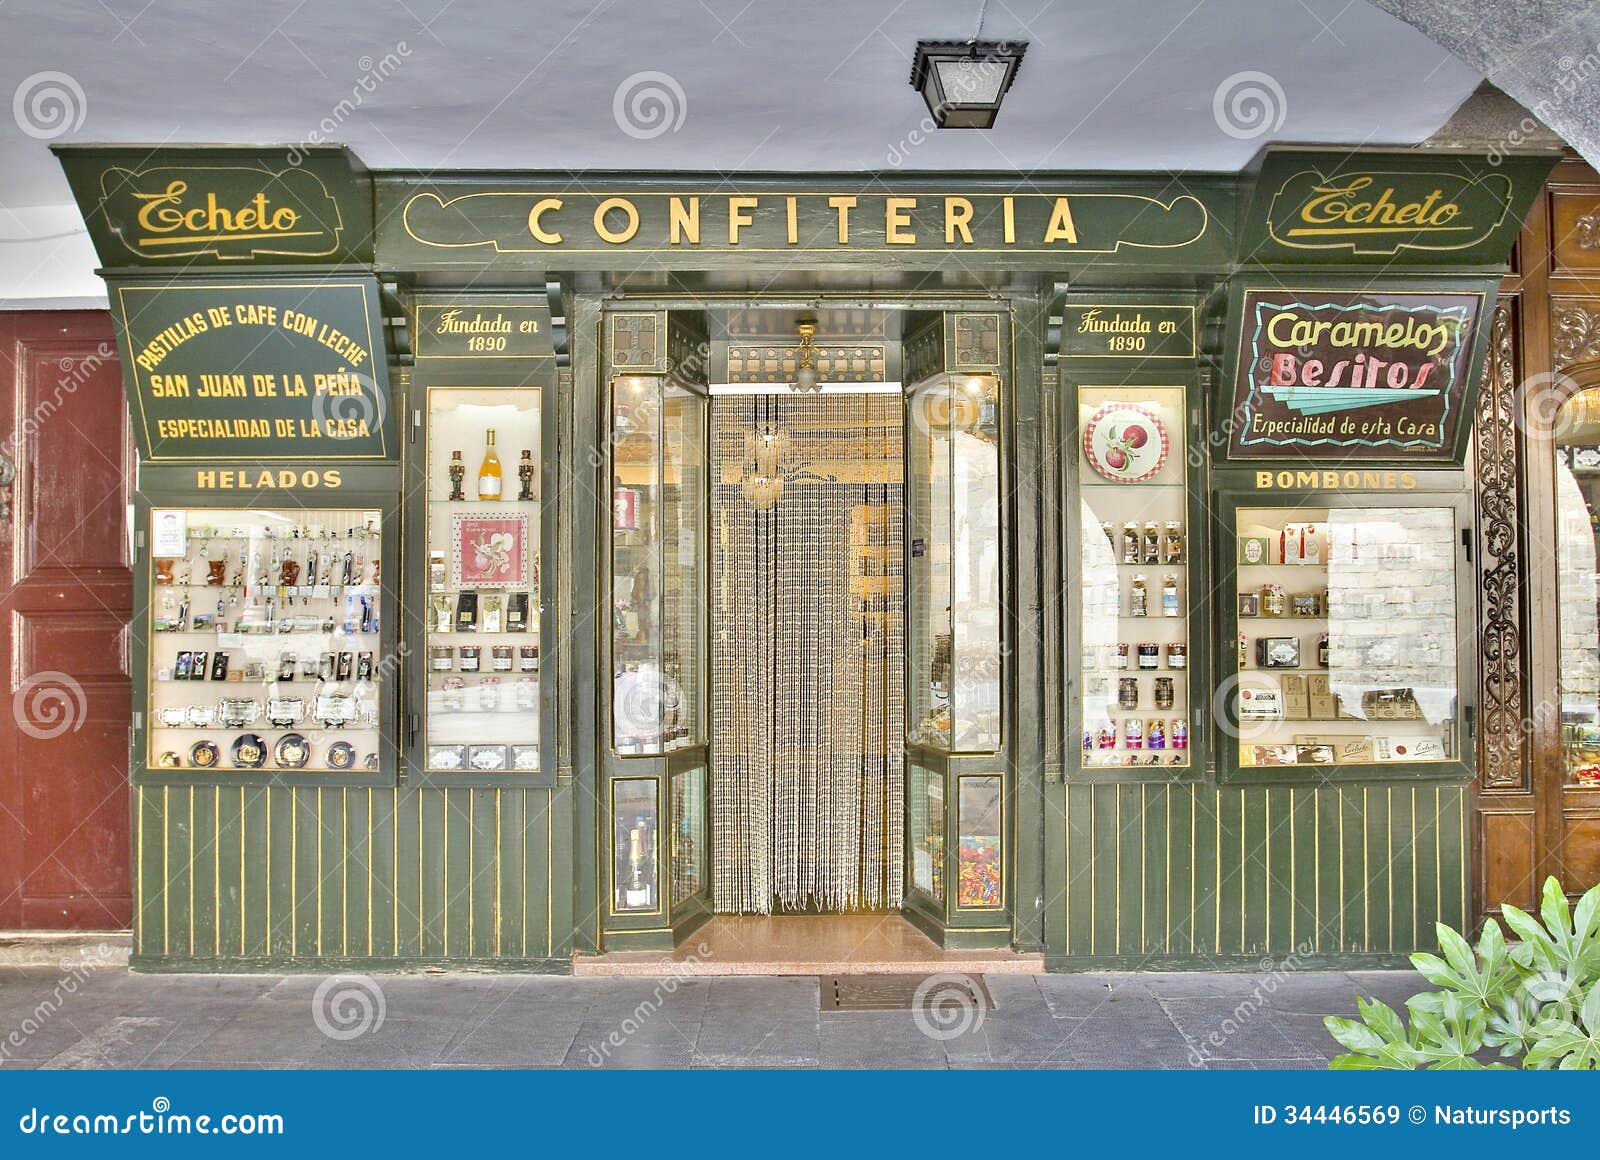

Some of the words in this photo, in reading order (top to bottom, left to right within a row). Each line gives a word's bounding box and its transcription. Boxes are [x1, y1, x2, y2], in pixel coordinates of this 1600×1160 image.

[131, 181, 302, 233] Echeto
[1301, 176, 1462, 225] Echeto
[528, 197, 1078, 245] CONFITERIA
[436, 309, 512, 335] Fundada
[520, 320, 539, 334] en
[1077, 310, 1151, 335] Fundada
[1158, 320, 1177, 334] en
[1267, 312, 1448, 357] Caramelos
[136, 311, 209, 373] PASTILLAS
[208, 307, 232, 329] DE
[236, 304, 276, 327] CAFE
[282, 310, 318, 338] CON
[318, 324, 368, 368] LECHE
[467, 336, 507, 352] 1890
[1107, 336, 1146, 352] 1890
[151, 374, 190, 398] SAN
[197, 374, 247, 398] JUAN
[254, 374, 277, 397] DE
[284, 374, 307, 397] LA
[315, 367, 363, 397] PEÑA
[158, 418, 271, 438] ESPECIALIDAD
[275, 418, 296, 437] DE
[300, 419, 320, 437] LA
[325, 419, 370, 437] CASA
[1252, 413, 1335, 436] Especialidad
[1340, 416, 1356, 432] de
[1361, 416, 1392, 435] esta
[1397, 416, 1436, 435] Casa
[197, 470, 342, 488] HELADOS
[1256, 471, 1418, 489] BOMBONES
